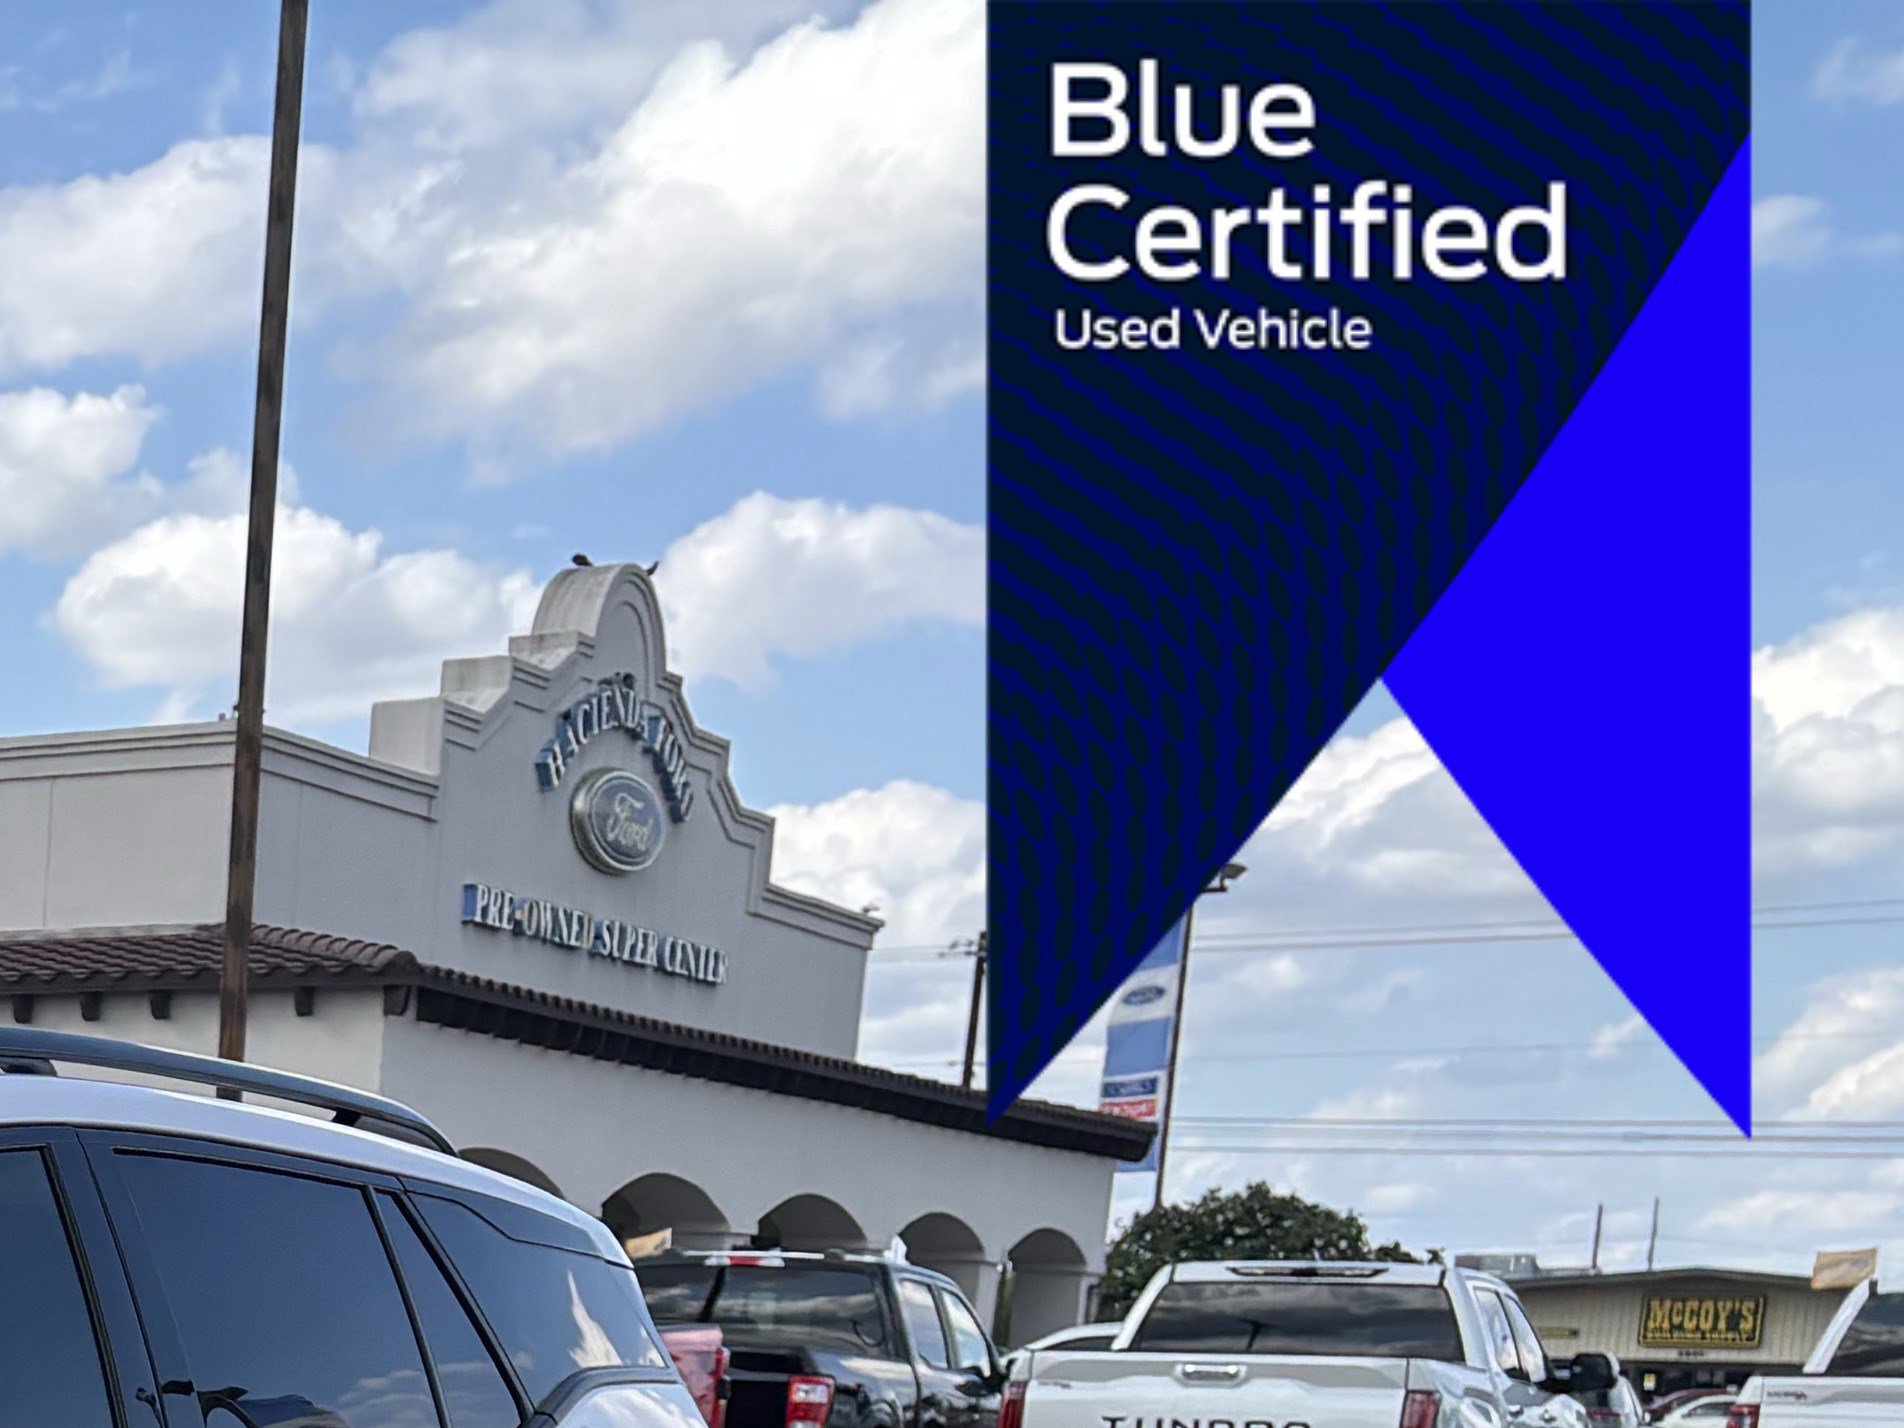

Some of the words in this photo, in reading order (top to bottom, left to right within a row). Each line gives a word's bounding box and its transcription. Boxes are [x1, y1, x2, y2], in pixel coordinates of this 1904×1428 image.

[537, 684, 648, 789] HACIENDA
[606, 792, 654, 851] Ford
[472, 883, 594, 950] PRE-OWNED
[600, 918, 659, 968] SUPER
[662, 935, 729, 984] CENTER
